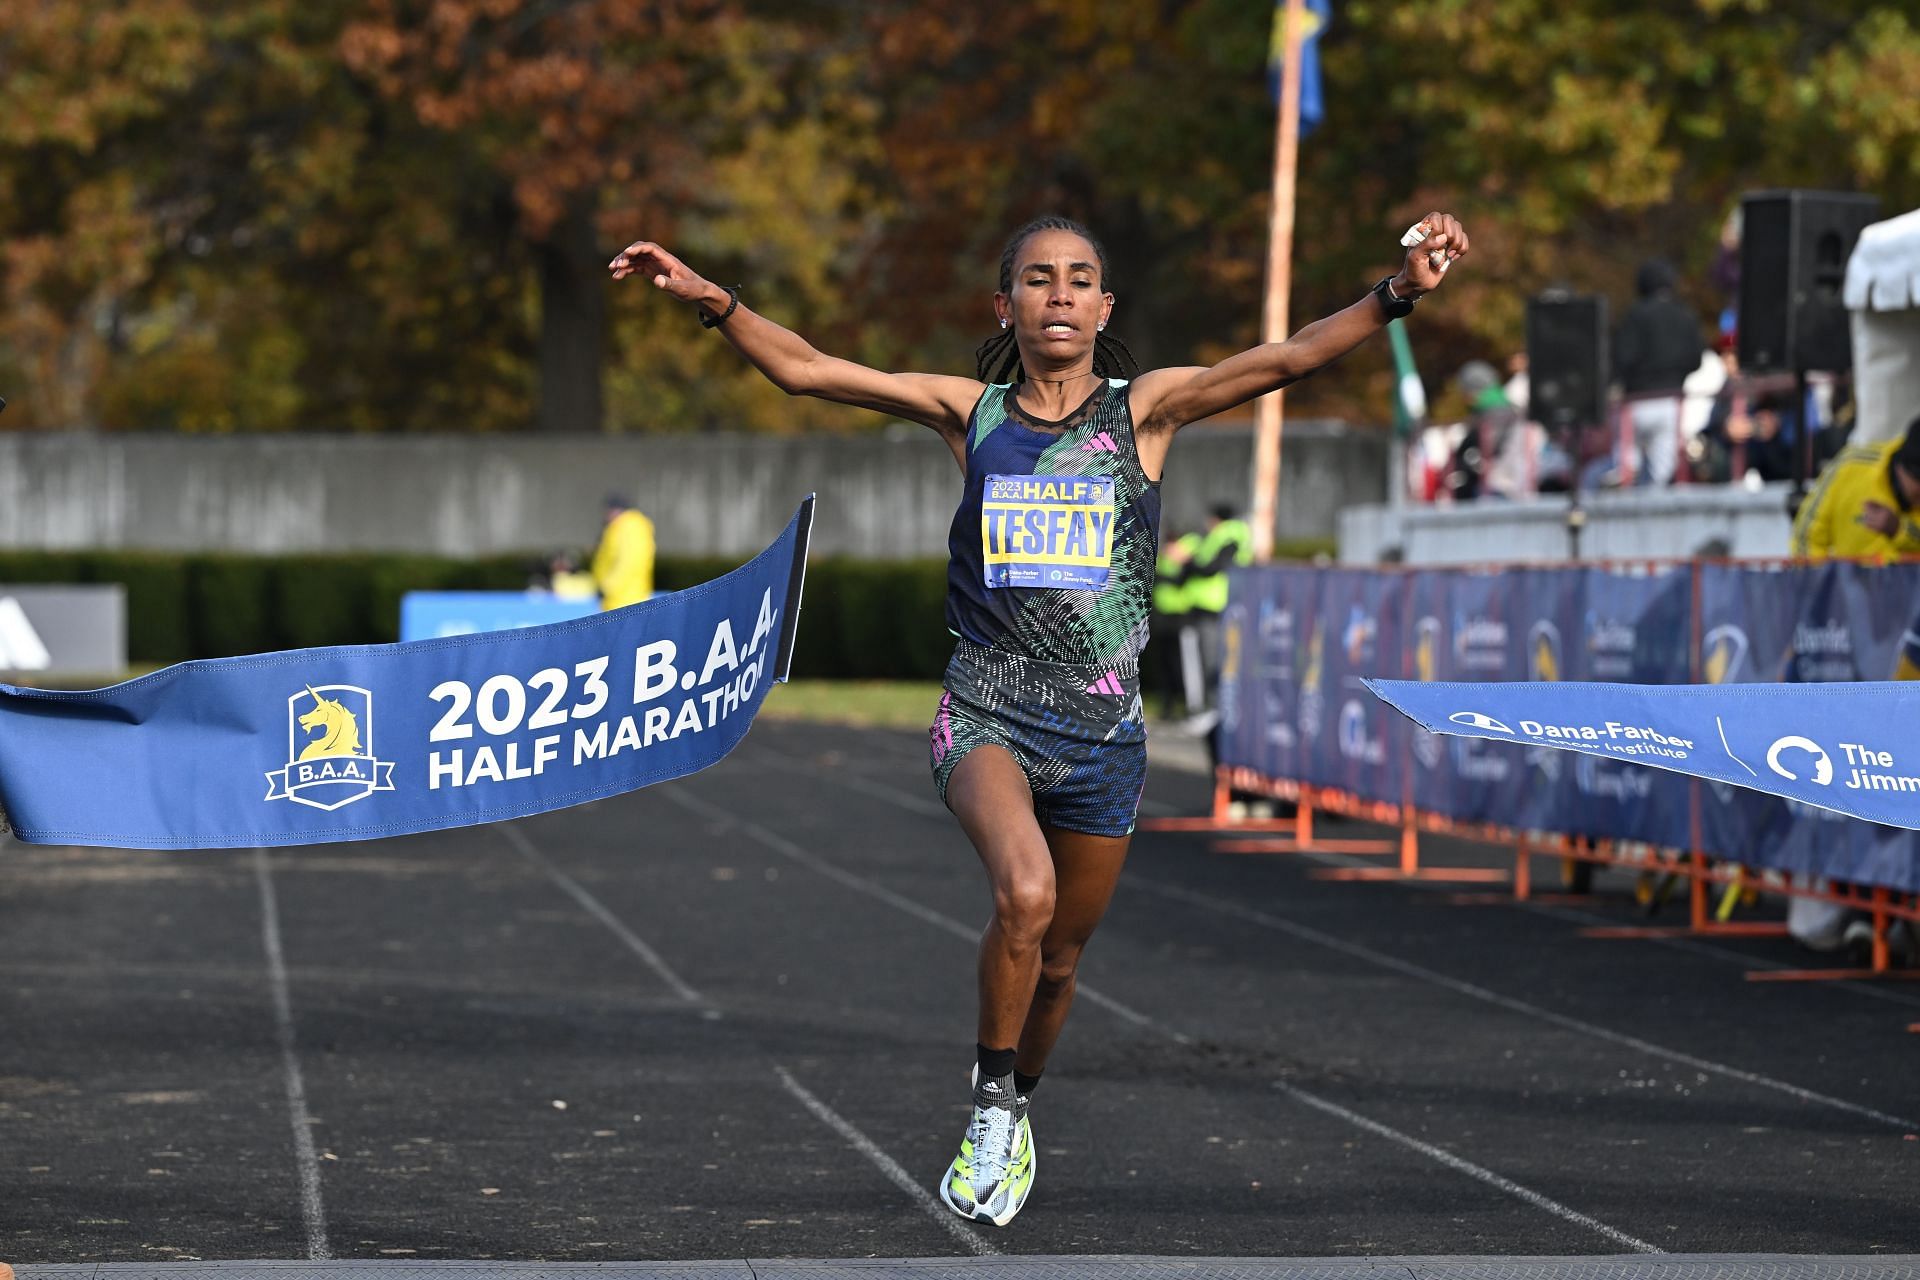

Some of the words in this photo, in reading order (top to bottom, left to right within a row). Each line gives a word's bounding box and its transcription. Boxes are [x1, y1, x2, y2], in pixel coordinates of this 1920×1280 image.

[991, 481, 1021, 491] 2023
[991, 491, 1023, 499] B.A.A.
[1023, 482, 1088, 500] HALF
[984, 508, 1112, 557] TESFAY
[428, 655, 610, 743] 2023
[633, 586, 778, 705] B.A.A.
[429, 734, 561, 790] HALF
[573, 641, 768, 767] MARATHON
[1519, 720, 1694, 750] Dana-Farber
[1604, 742, 1688, 760] Institute
[1838, 743, 1894, 768] The
[298, 761, 366, 782] B.A.A.
[1845, 768, 1920, 792] Jimm
